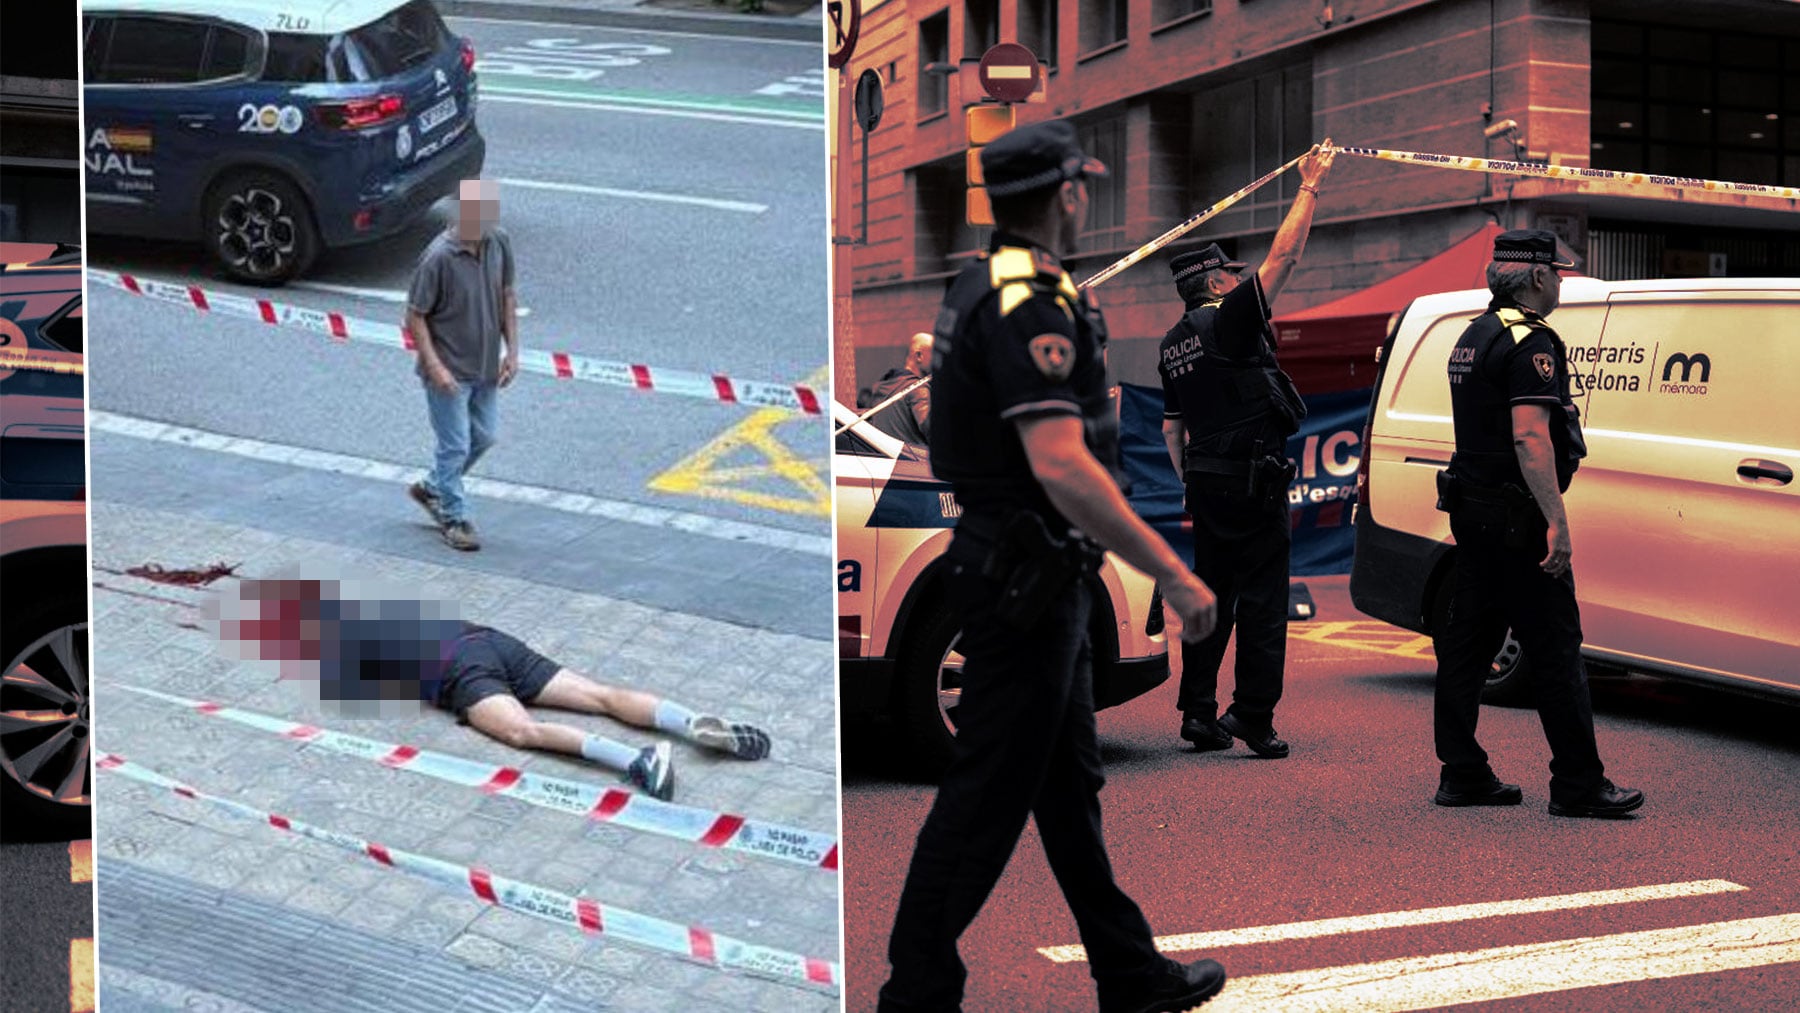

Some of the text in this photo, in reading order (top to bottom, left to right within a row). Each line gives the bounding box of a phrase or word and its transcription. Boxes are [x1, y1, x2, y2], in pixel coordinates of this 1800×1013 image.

[473, 37, 673, 81] BUS
[88, 127, 112, 150] A
[84, 152, 155, 177] NAL
[1486, 159, 1517, 172] POLICIA
[1162, 334, 1203, 365] POLICIA
[1567, 341, 1646, 365] uneraris
[1568, 368, 1641, 393] rcelona
[1301, 429, 1361, 480] IC
[837, 558, 862, 593] a
